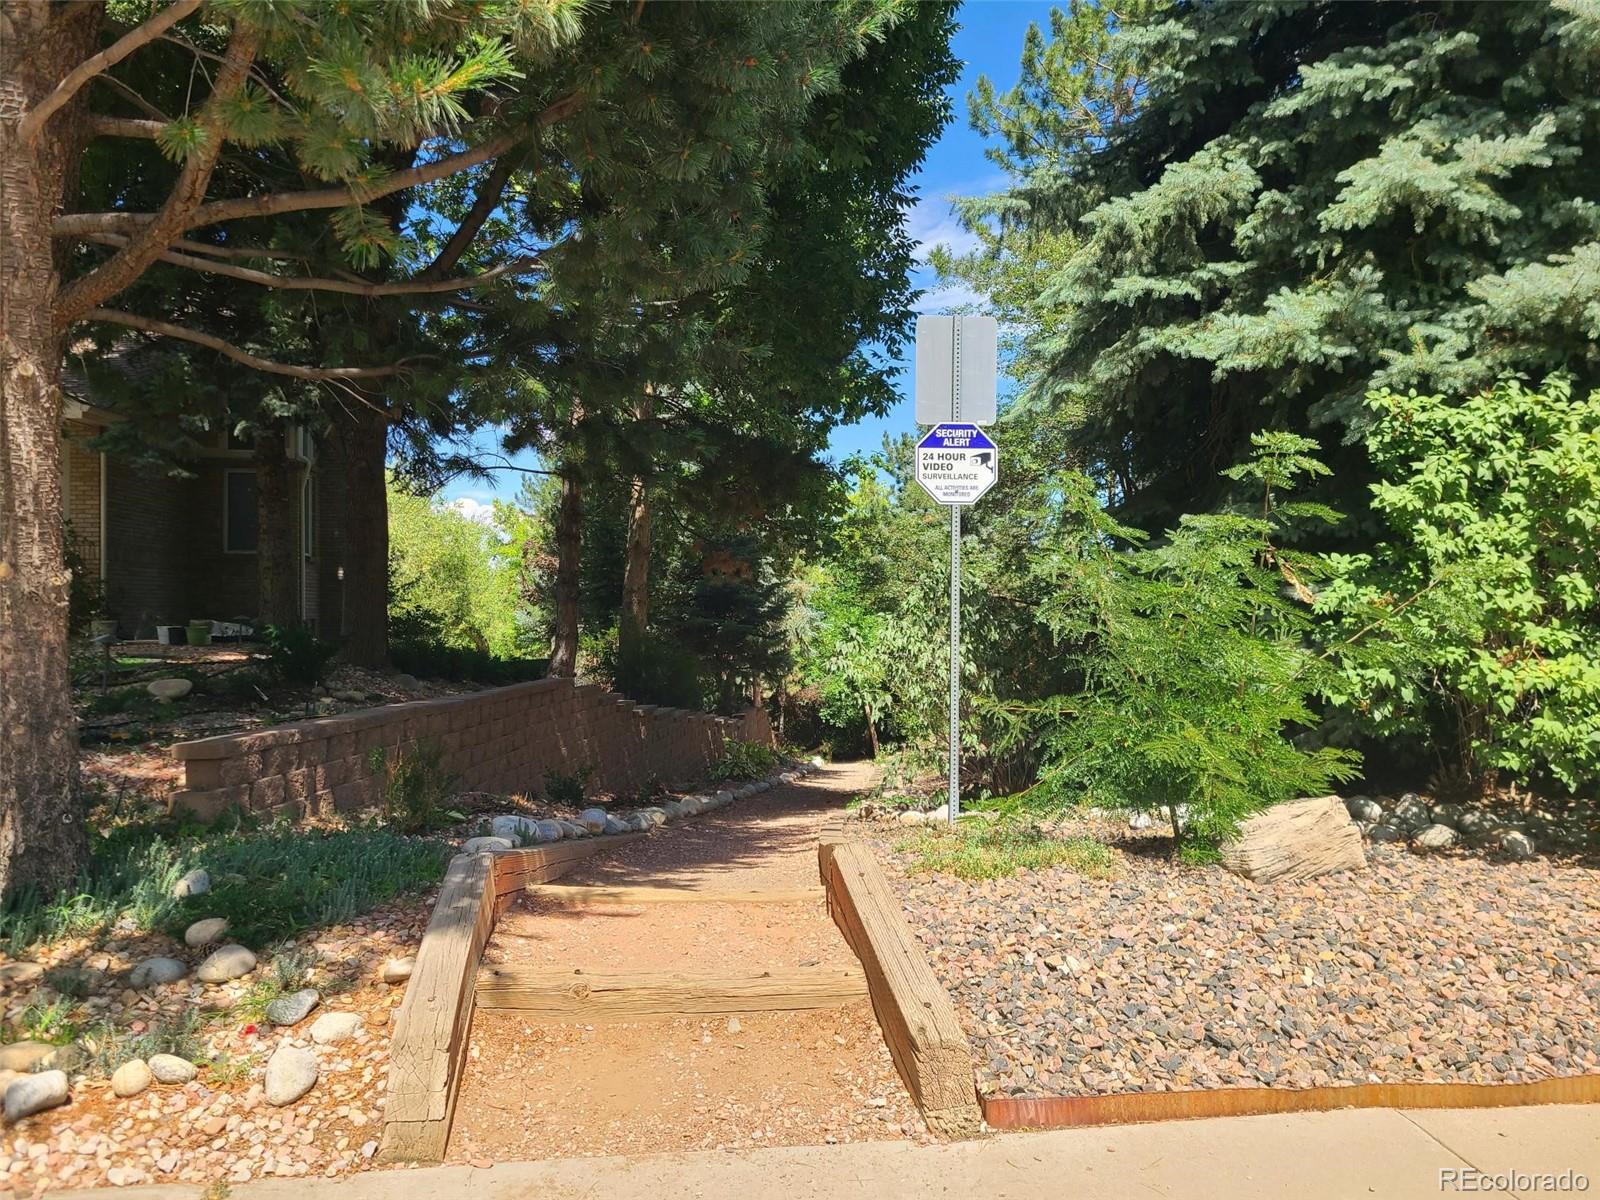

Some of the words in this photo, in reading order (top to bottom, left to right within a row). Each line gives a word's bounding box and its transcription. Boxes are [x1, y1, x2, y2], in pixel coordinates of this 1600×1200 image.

[935, 429, 978, 438] SECURITY
[943, 438, 971, 447] ALERT
[922, 453, 934, 461] 24
[937, 453, 966, 461] HOUR
[922, 463, 953, 471] VIDEO
